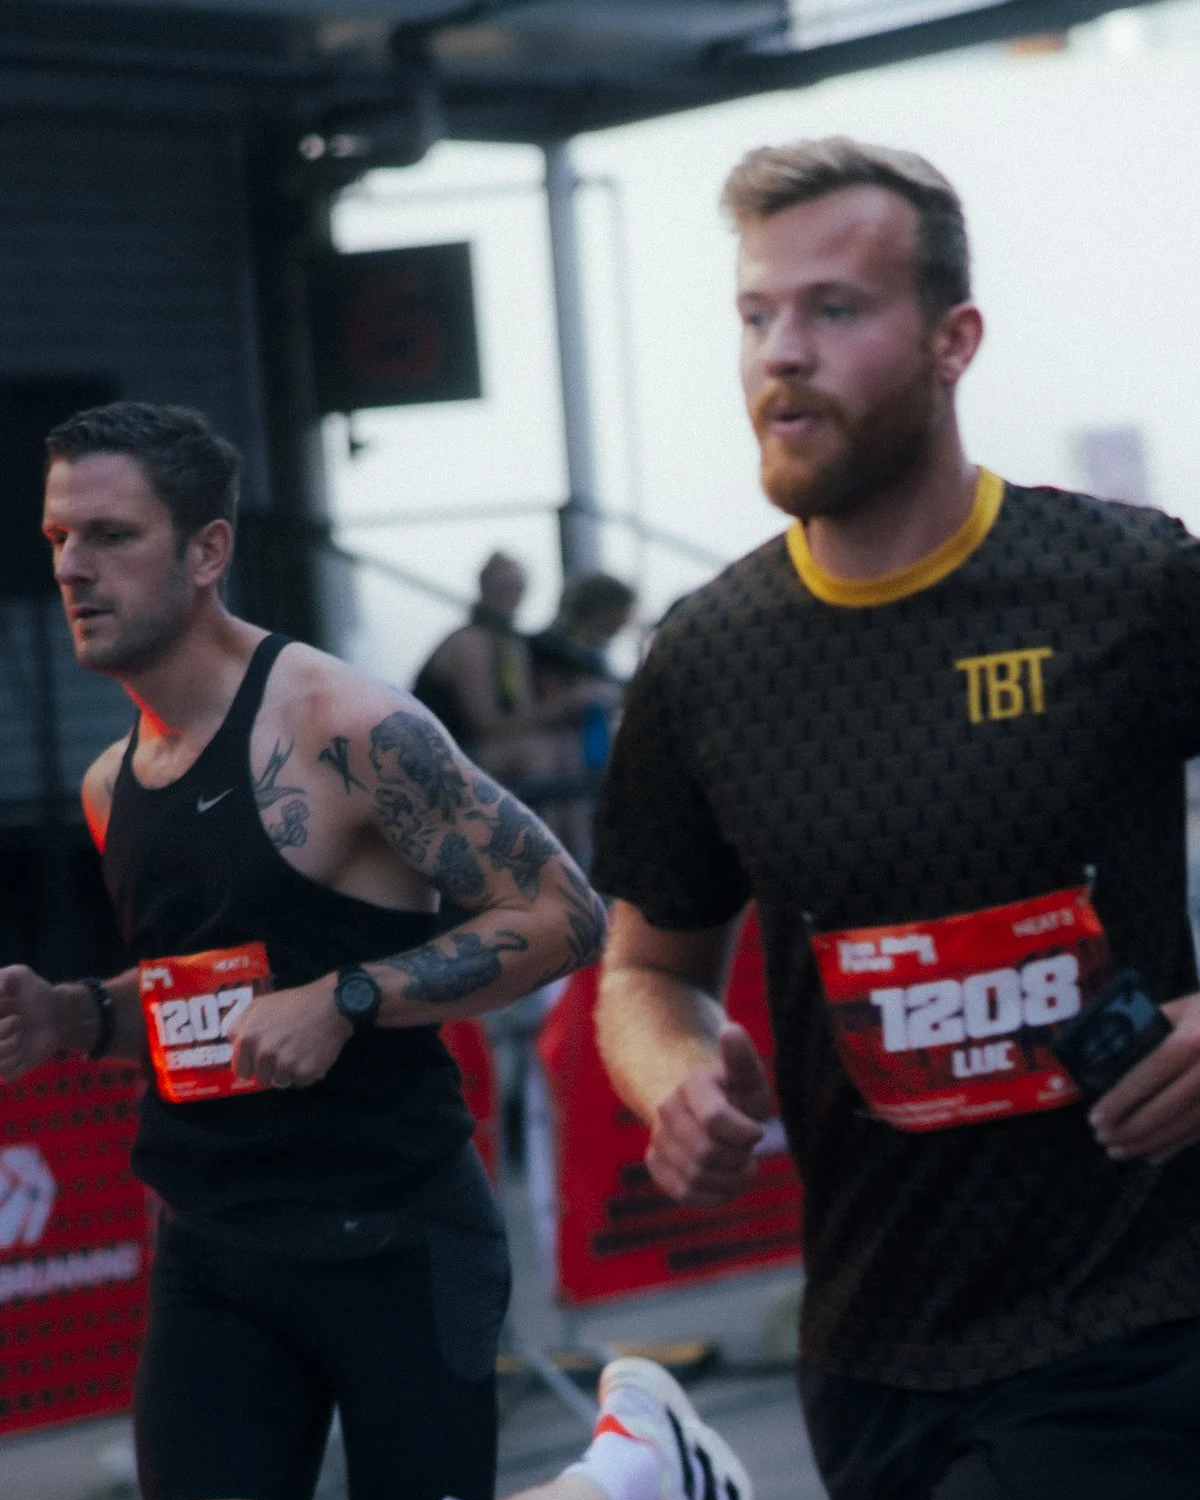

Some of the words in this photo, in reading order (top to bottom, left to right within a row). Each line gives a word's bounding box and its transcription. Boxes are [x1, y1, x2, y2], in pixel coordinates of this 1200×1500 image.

[954, 647, 1054, 725] TBT
[149, 985, 253, 1048] 1207
[869, 953, 1082, 1054] 1208
[952, 1039, 1016, 1079] LUC
